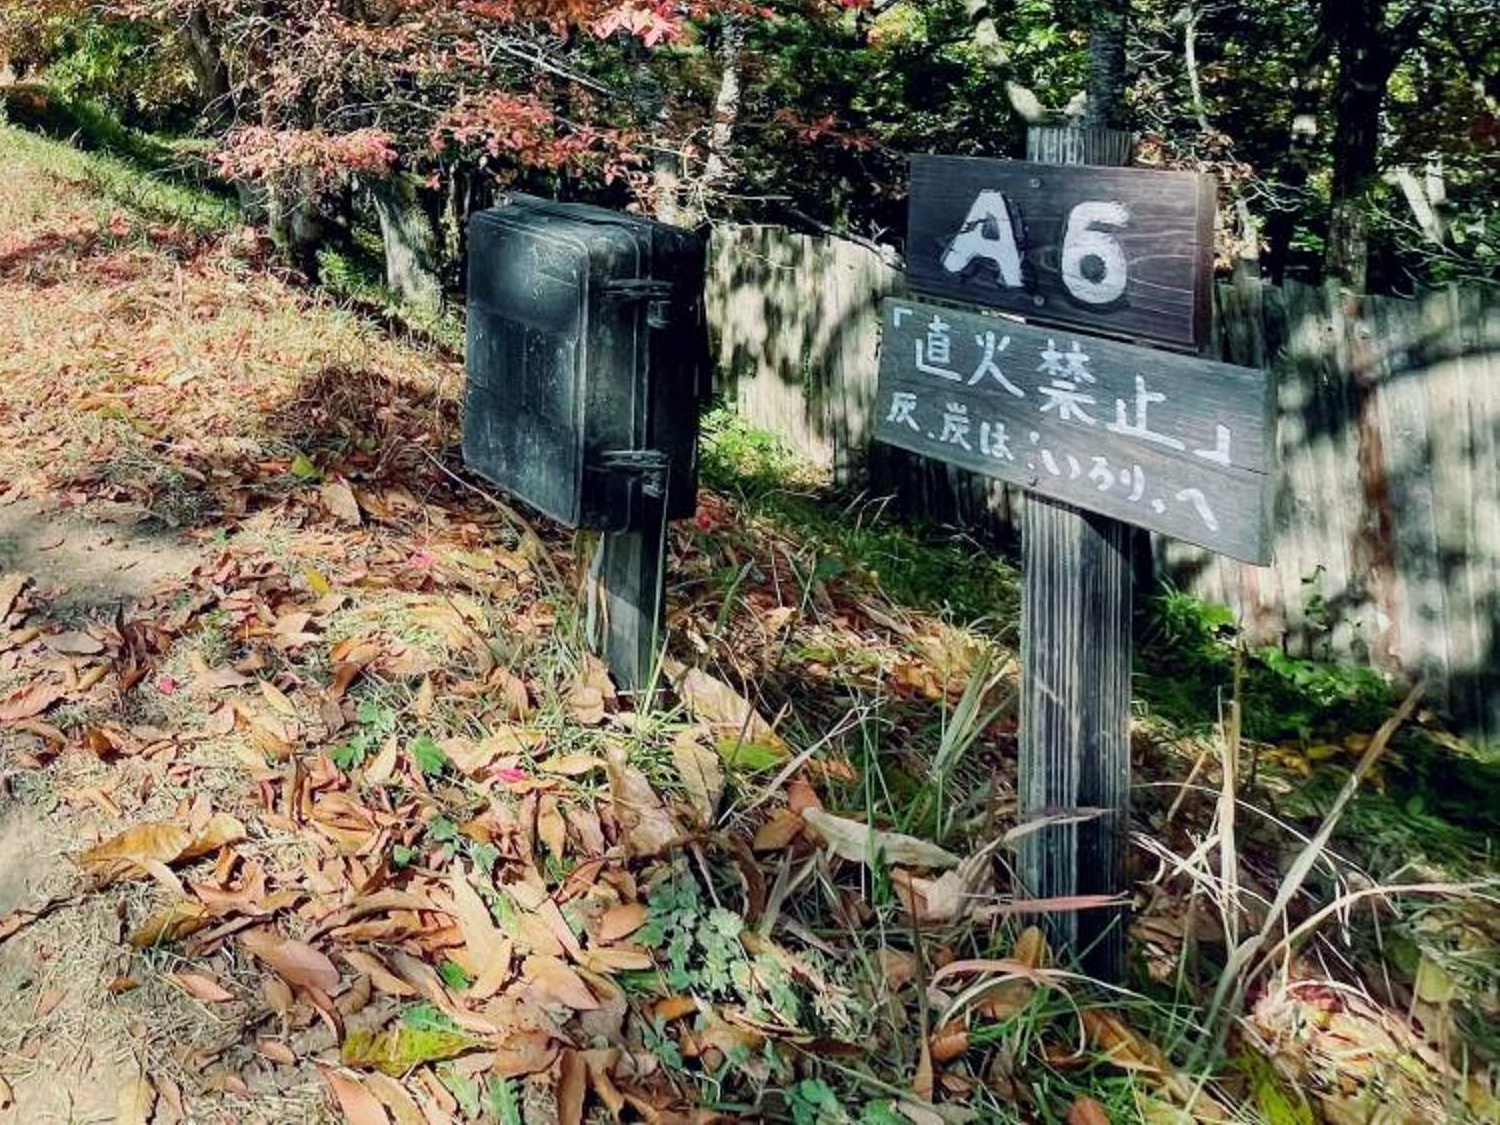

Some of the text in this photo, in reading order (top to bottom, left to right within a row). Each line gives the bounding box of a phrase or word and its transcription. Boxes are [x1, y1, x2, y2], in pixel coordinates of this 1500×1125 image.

[941, 188, 1130, 304] A6
[893, 307, 1232, 467] 「直火禁止」
